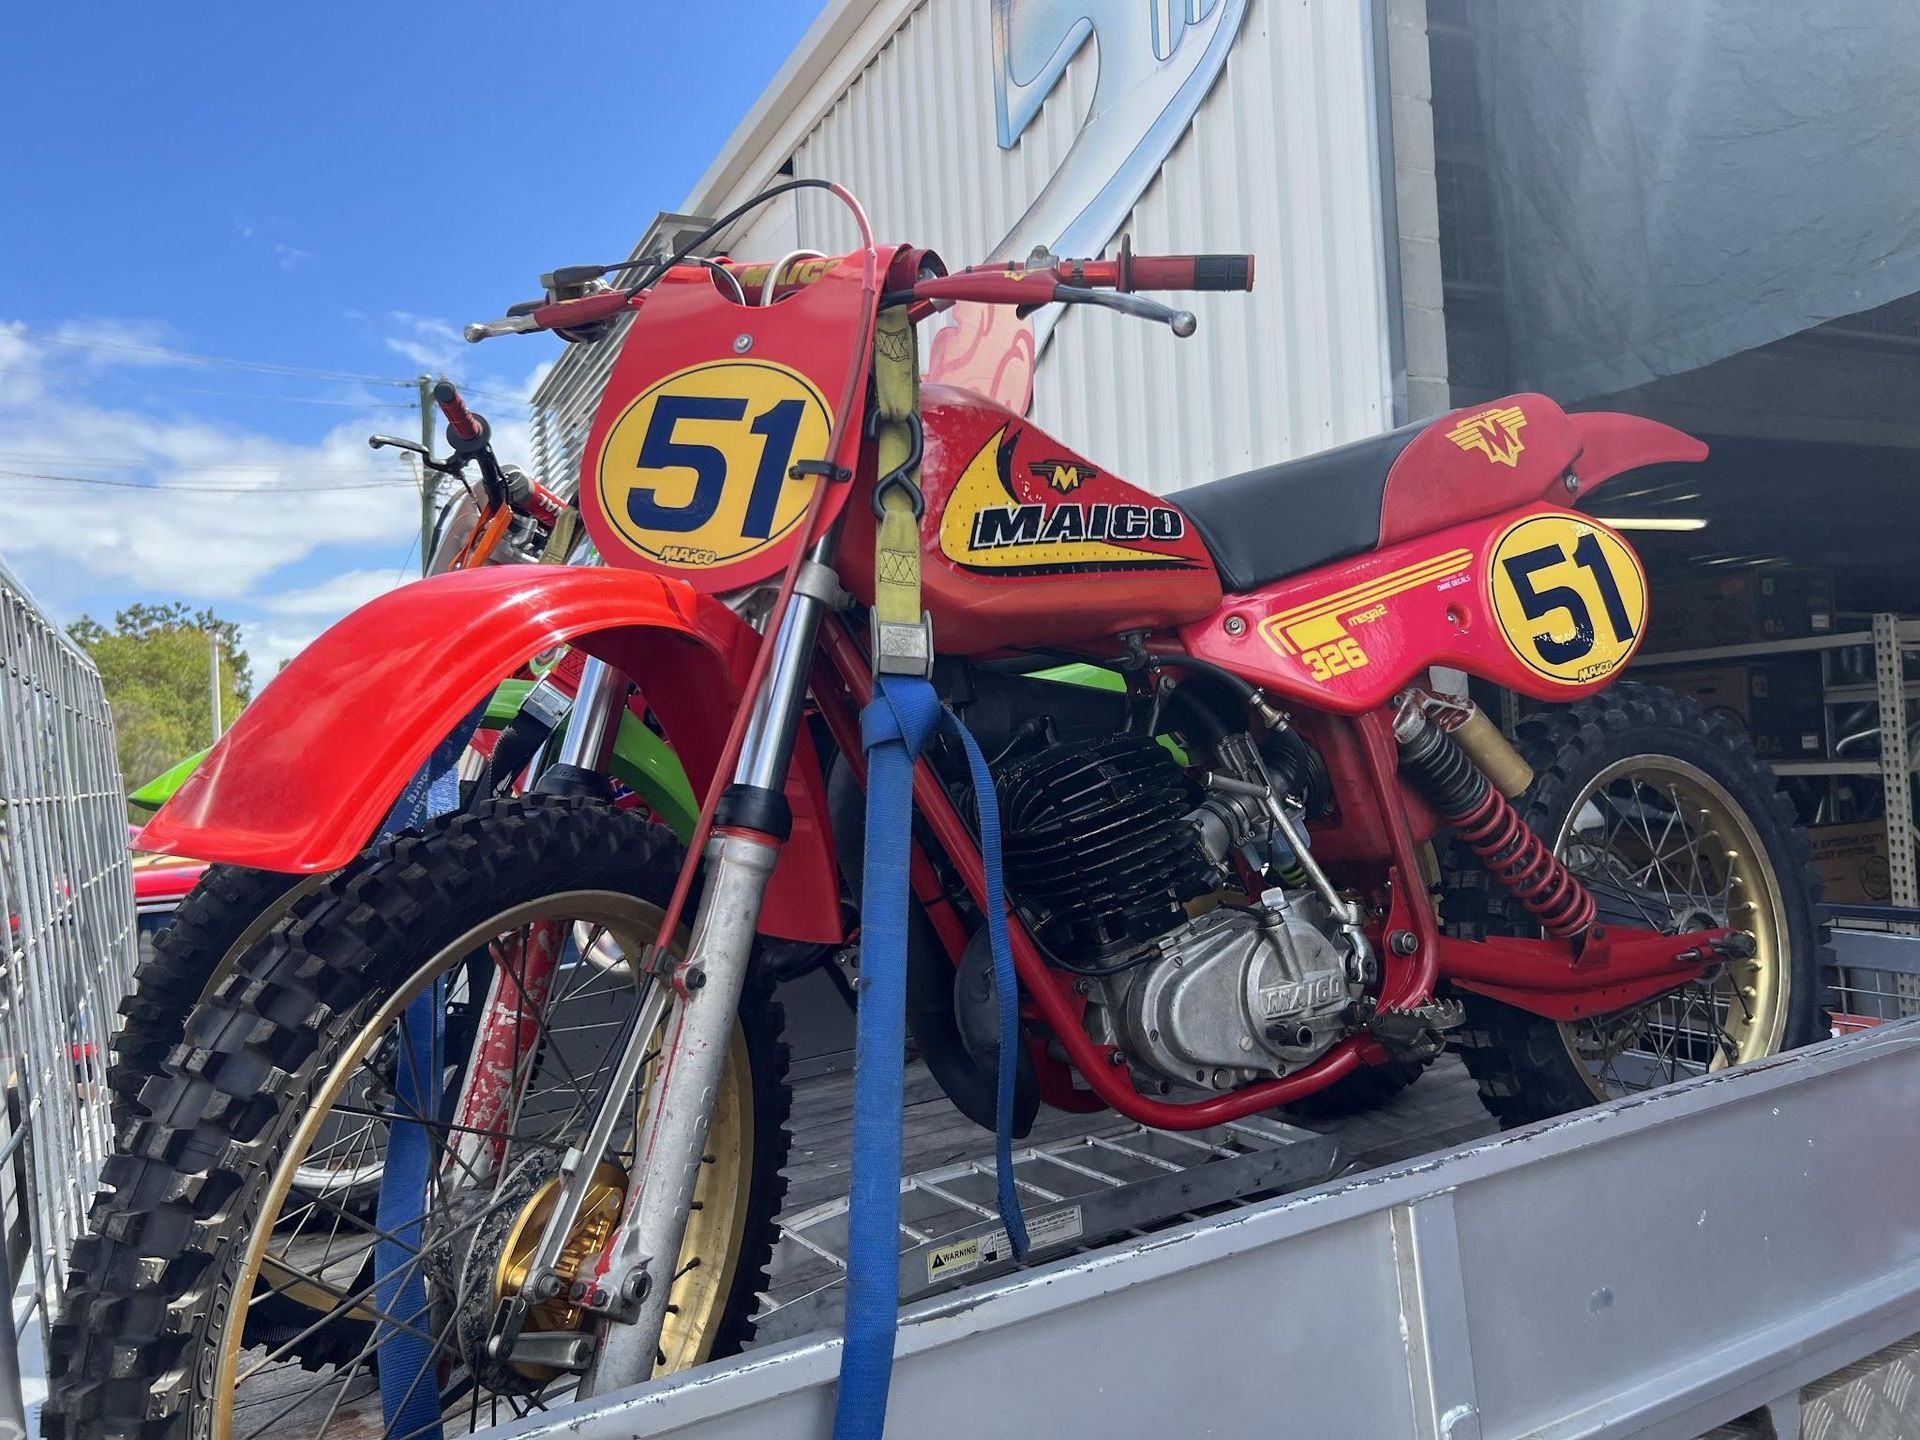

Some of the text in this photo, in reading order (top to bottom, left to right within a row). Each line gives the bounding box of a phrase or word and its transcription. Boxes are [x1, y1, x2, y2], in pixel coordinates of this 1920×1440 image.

[626, 395, 807, 541] 51
[968, 503, 1185, 552] MAICO
[1502, 532, 1634, 666] 51
[1301, 636, 1370, 682] 326
[1264, 976, 1345, 1016] MAICO
[943, 1245, 977, 1262] WARNING
